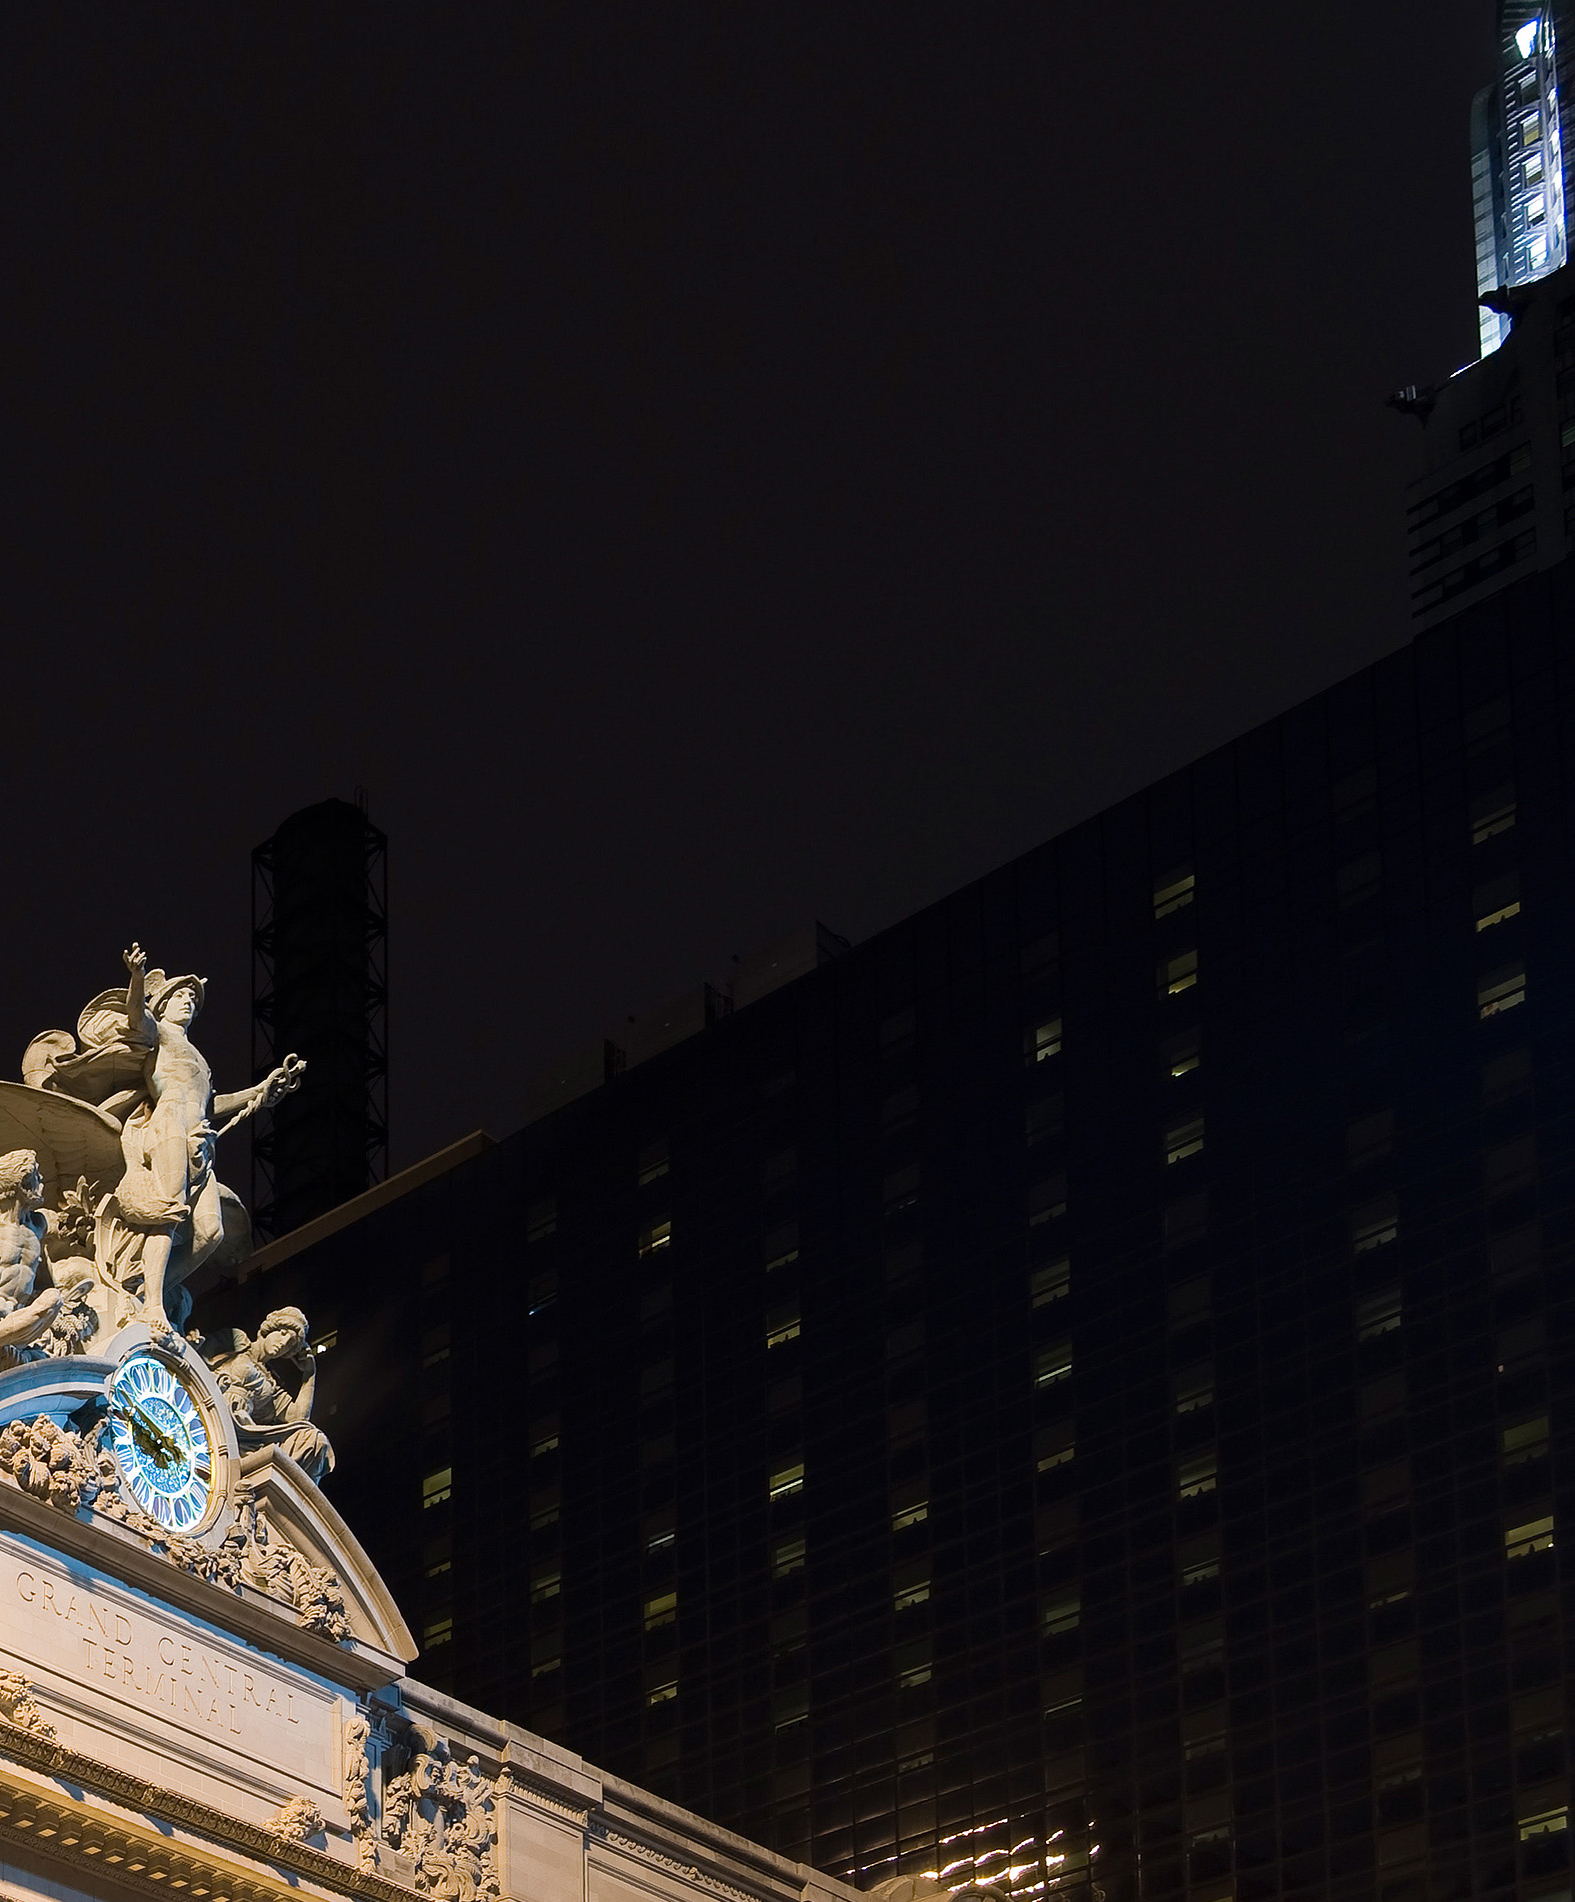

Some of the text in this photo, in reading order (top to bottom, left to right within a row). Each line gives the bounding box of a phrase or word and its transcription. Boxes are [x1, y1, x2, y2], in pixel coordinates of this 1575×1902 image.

[17, 1571, 299, 1724] GRAND CENTRAL
[82, 1637, 241, 1735] TERMINAL
